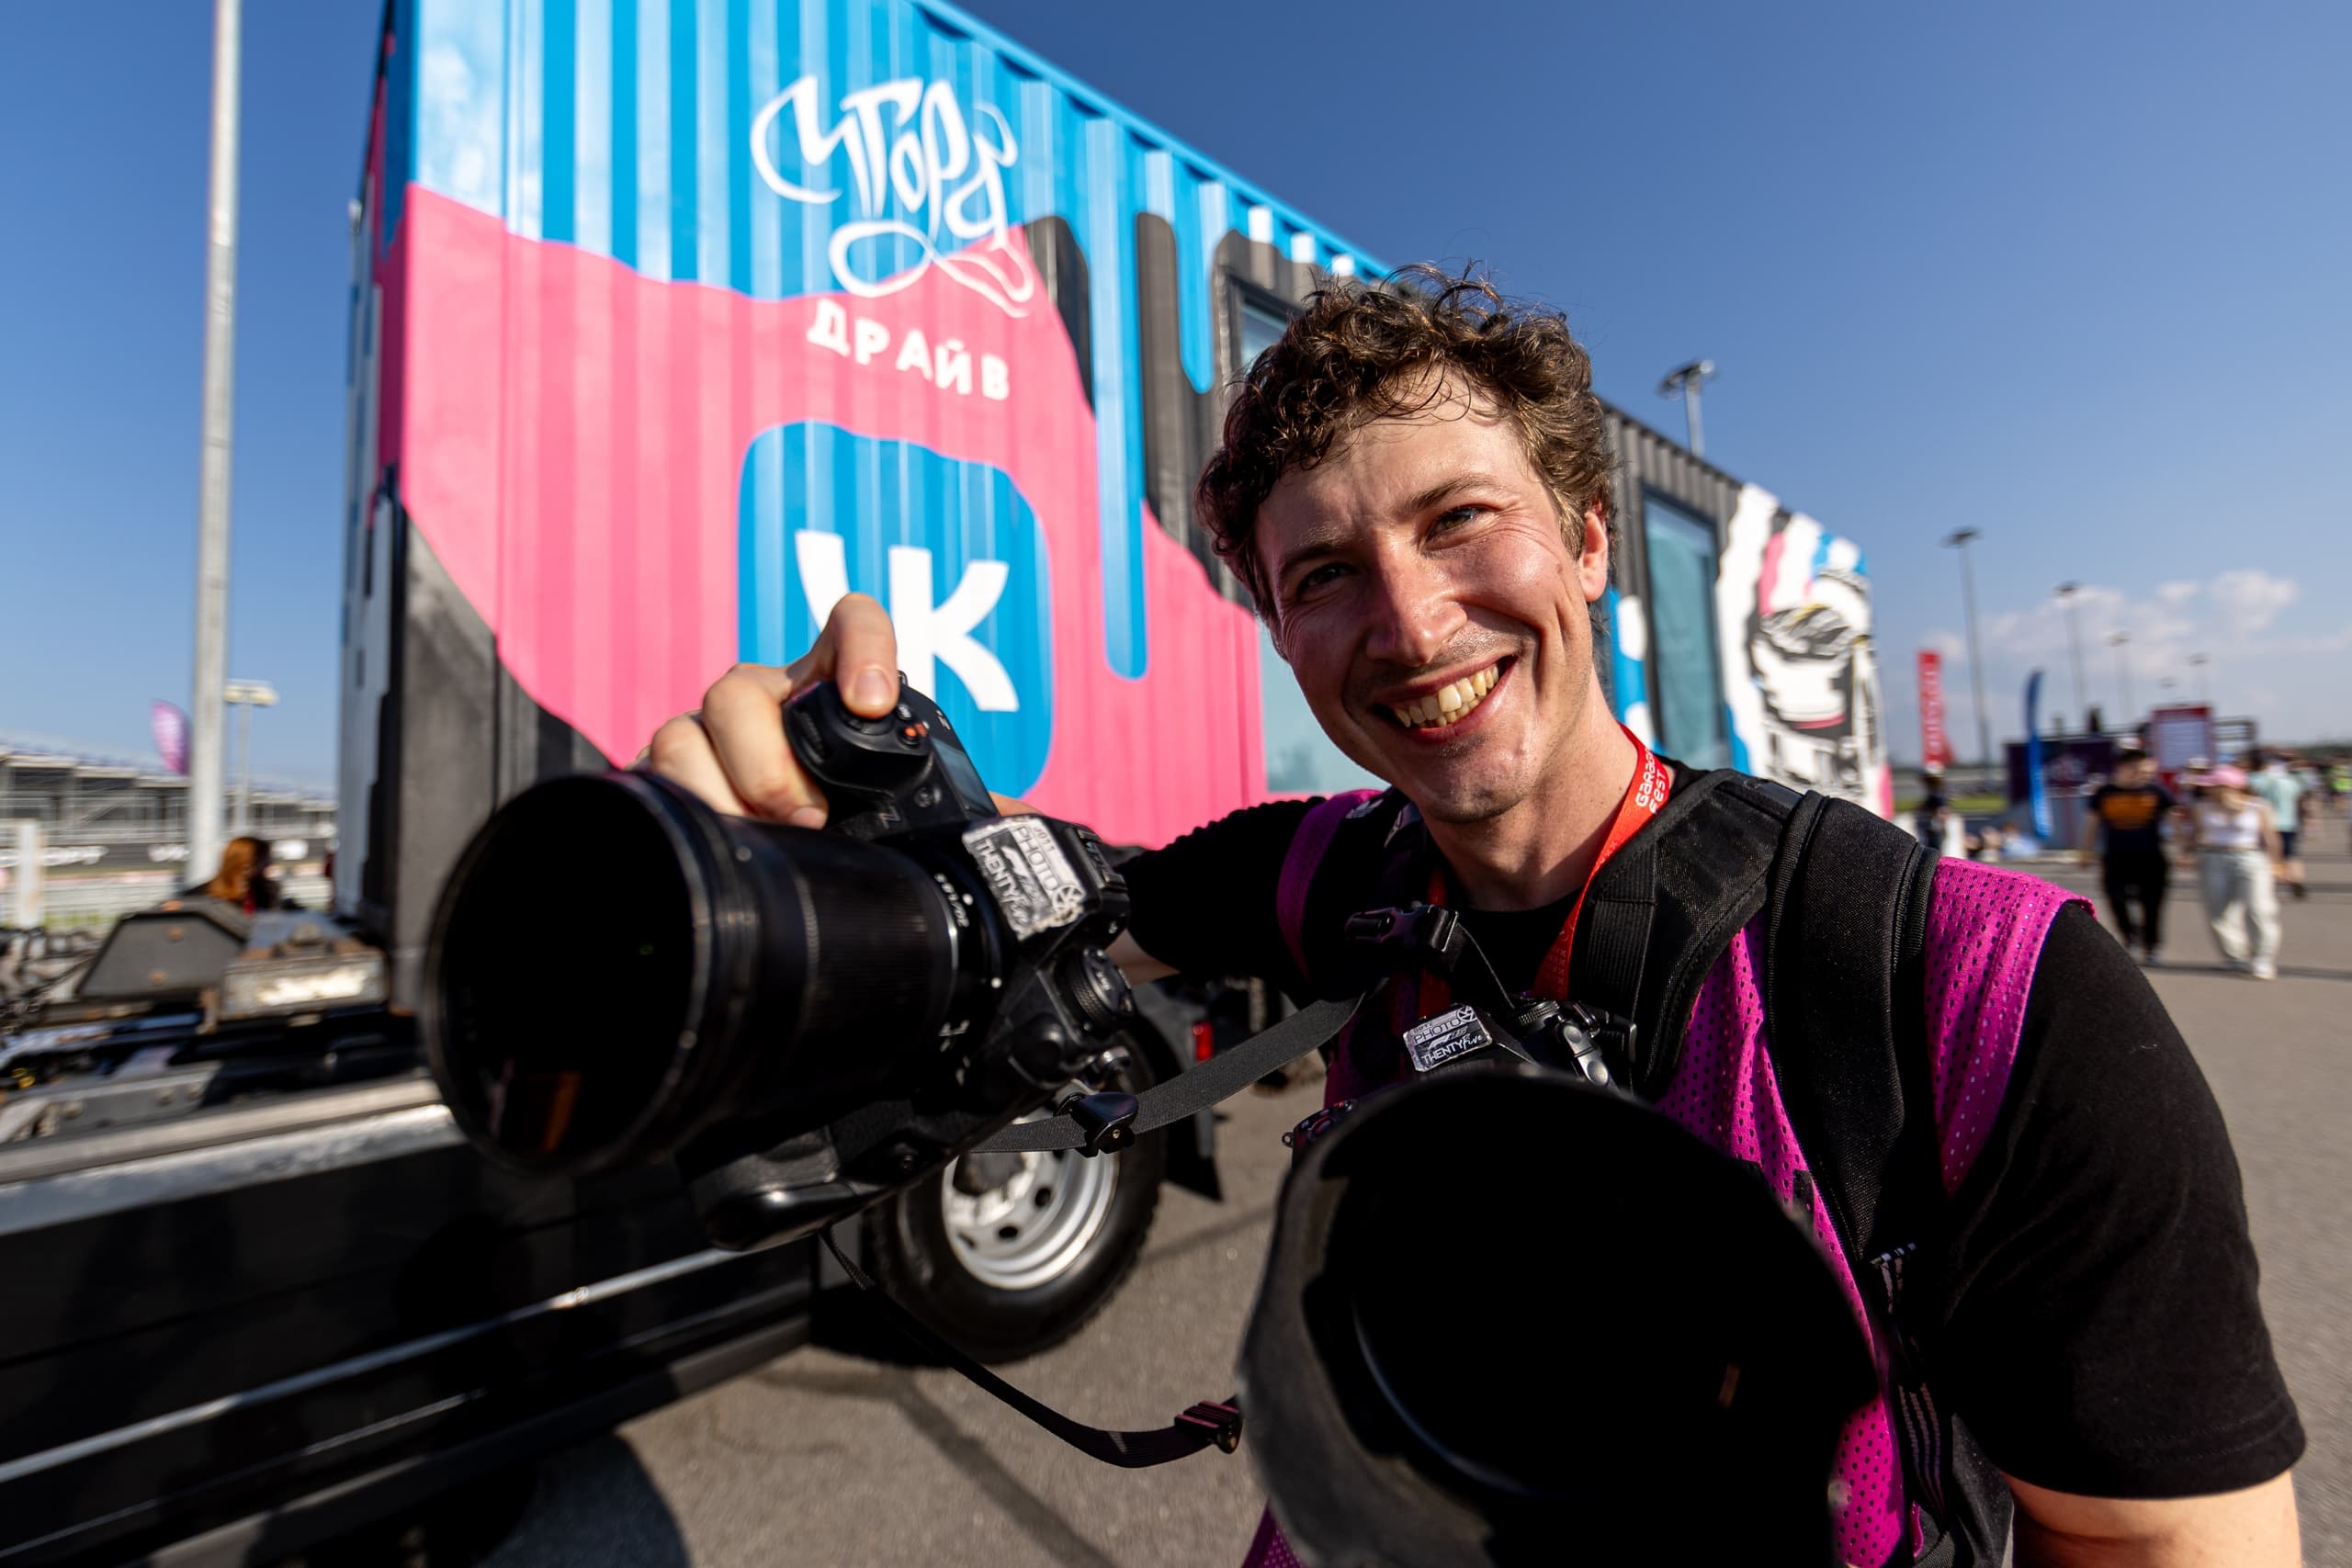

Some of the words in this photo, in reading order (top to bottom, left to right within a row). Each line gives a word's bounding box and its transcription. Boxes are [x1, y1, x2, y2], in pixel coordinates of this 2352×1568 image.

[806, 299, 1010, 400] ДРАЙВ
[1014, 826, 1059, 892] PHOTO
[1415, 1018, 1461, 1044] PHOTO
